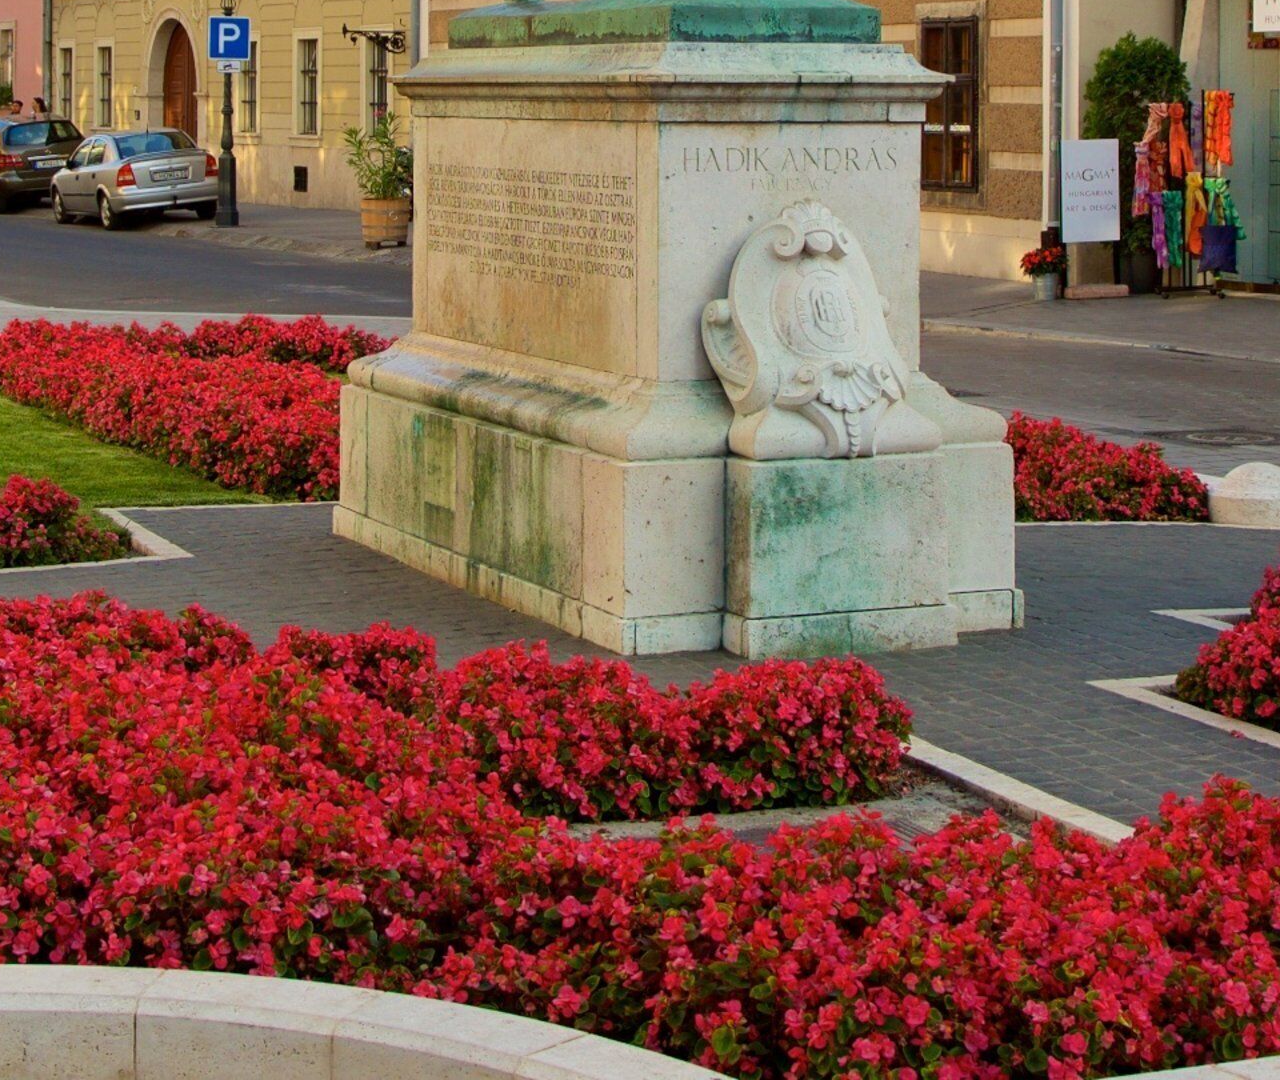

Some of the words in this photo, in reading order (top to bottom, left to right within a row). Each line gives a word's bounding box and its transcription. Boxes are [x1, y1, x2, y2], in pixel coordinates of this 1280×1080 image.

[219, 23, 240, 54] P
[683, 147, 770, 172] HADIK
[782, 142, 898, 172] ANDRÁS
[1089, 204, 1117, 212] DESIGN
